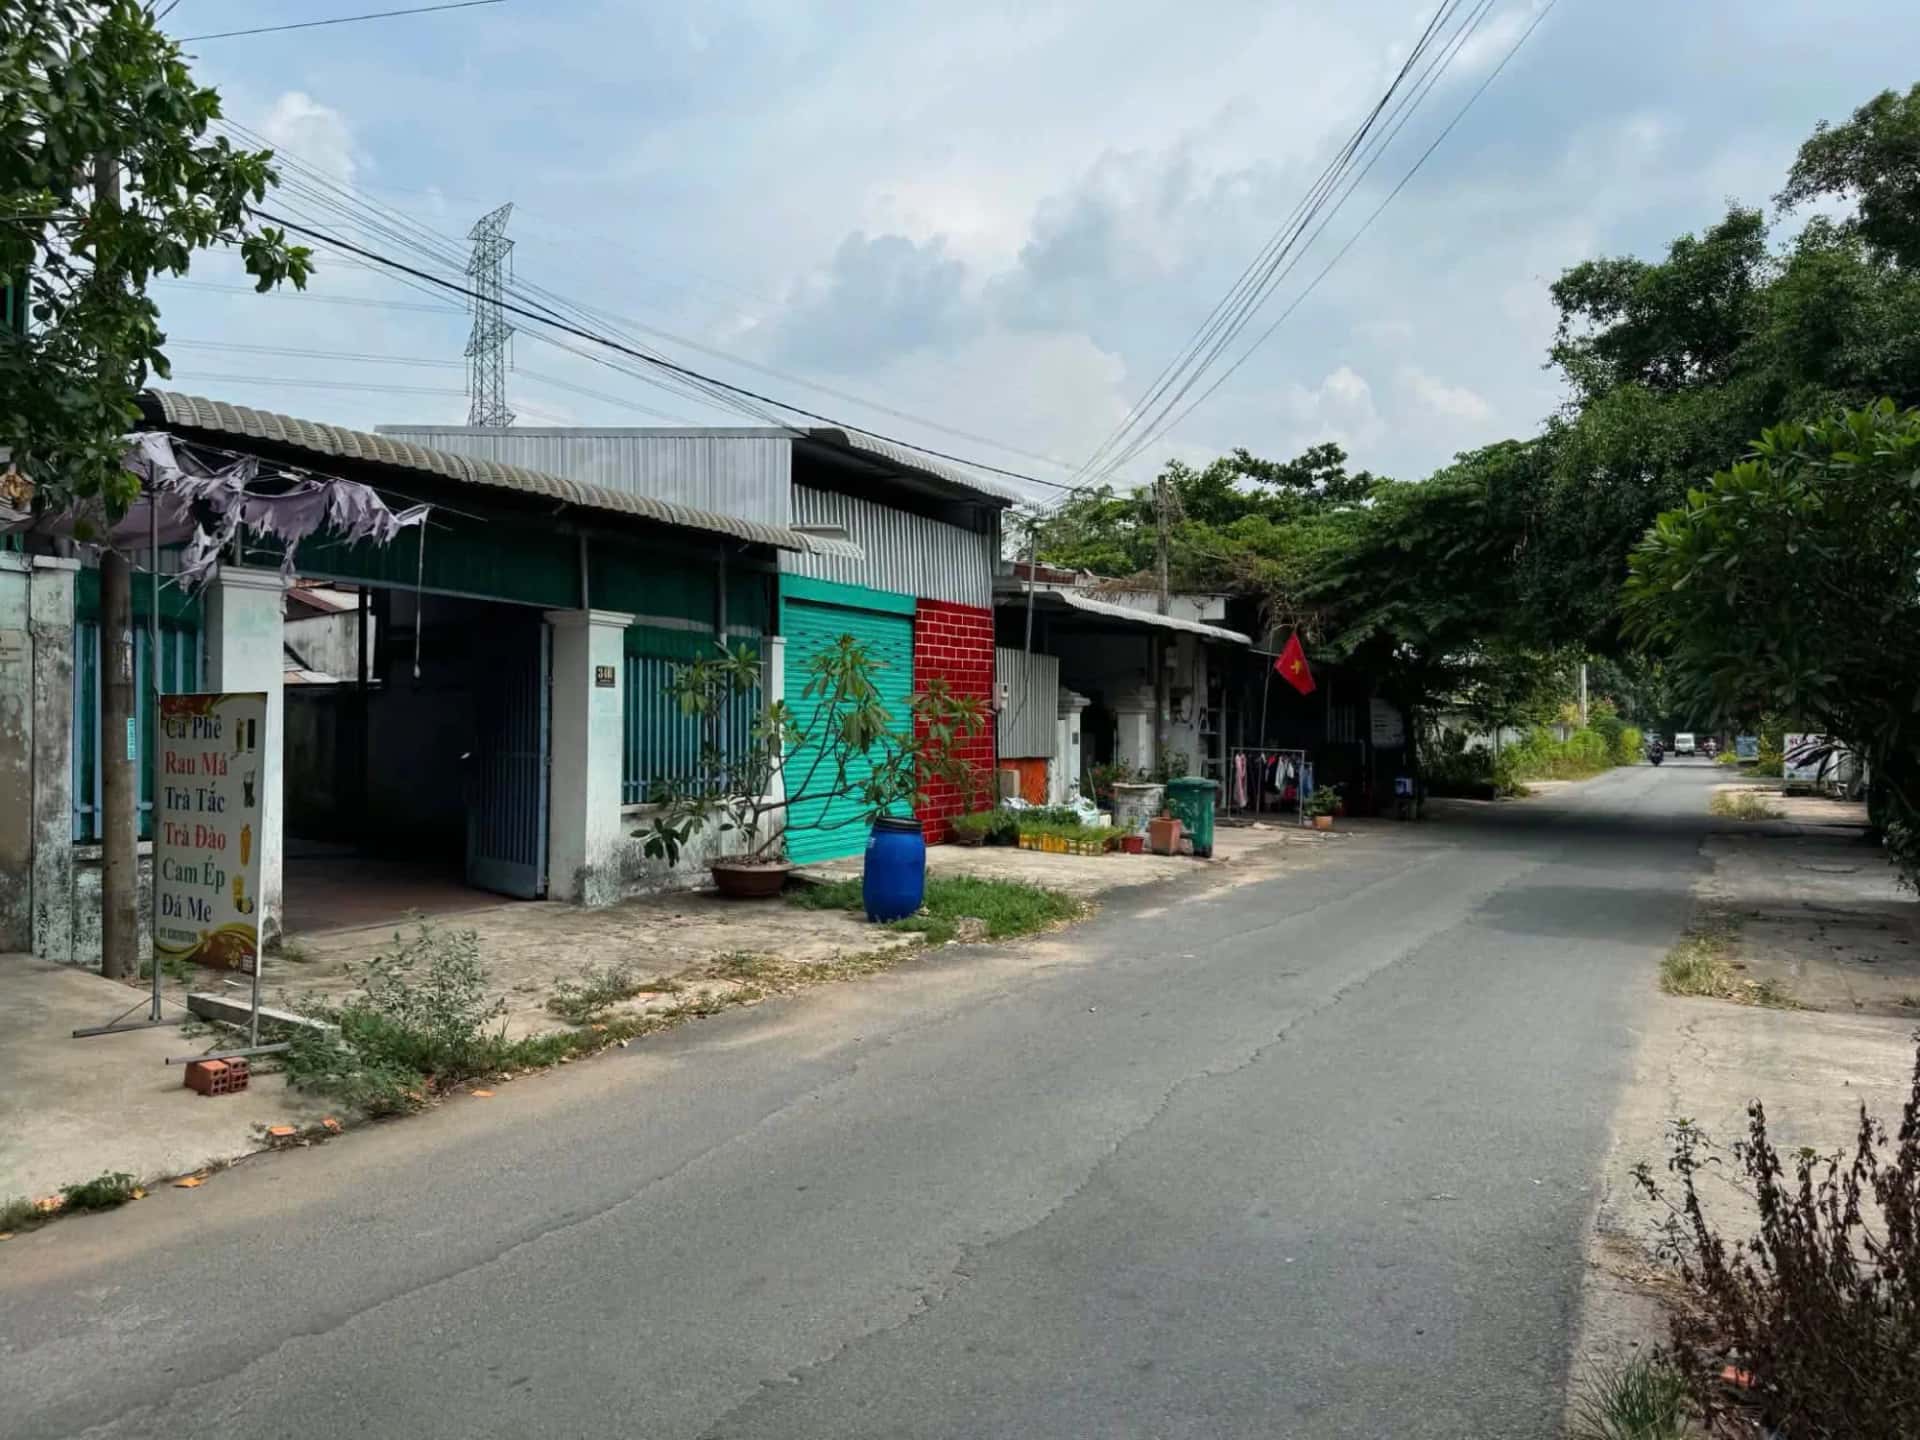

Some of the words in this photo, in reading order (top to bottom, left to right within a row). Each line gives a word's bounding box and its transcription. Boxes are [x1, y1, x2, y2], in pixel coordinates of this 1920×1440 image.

[193, 714, 222, 739] Phê
[165, 751, 195, 775] Rau
[202, 750, 228, 776] Má
[164, 786, 190, 811] Trà
[195, 780, 225, 813] Tắc
[164, 822, 189, 848] Trà
[195, 824, 226, 850] Đào
[163, 857, 198, 884] Cam
[203, 854, 225, 894] Ép
[161, 892, 182, 917] Đá
[188, 896, 212, 922] Me
